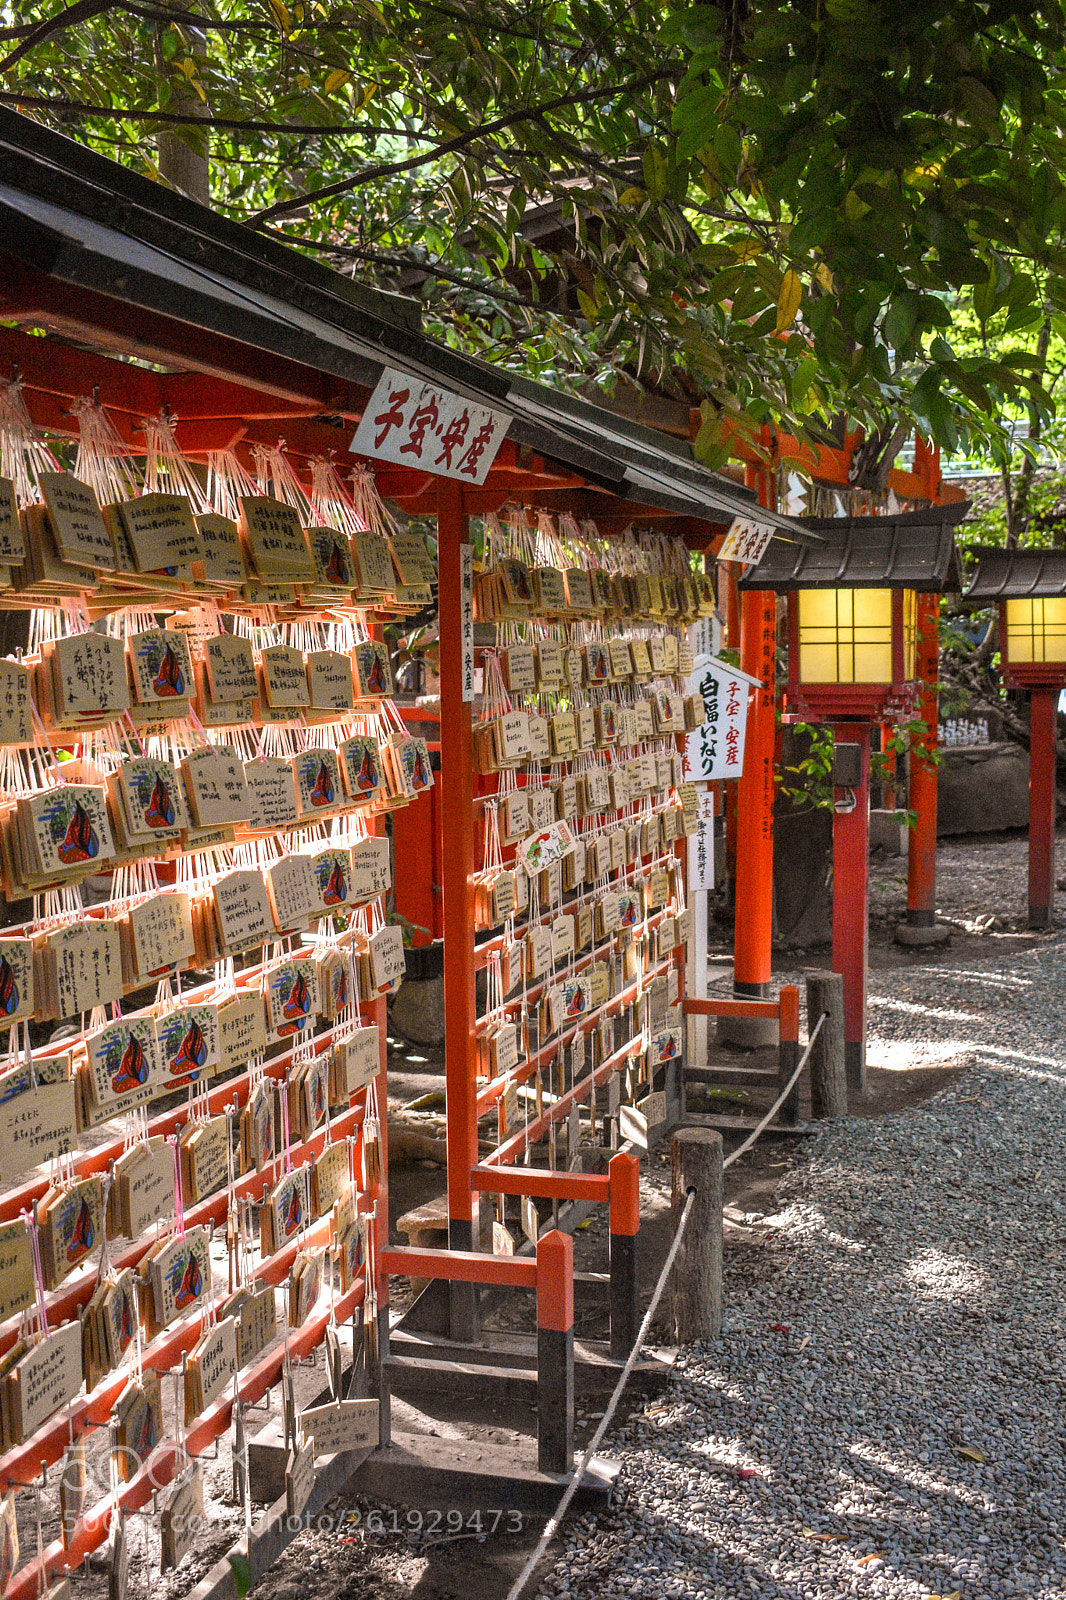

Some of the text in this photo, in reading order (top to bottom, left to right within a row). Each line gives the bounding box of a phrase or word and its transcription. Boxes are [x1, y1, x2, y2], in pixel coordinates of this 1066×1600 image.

[699, 671, 720, 777] 白福いなり
[725, 681, 741, 766] 子宝・安産
